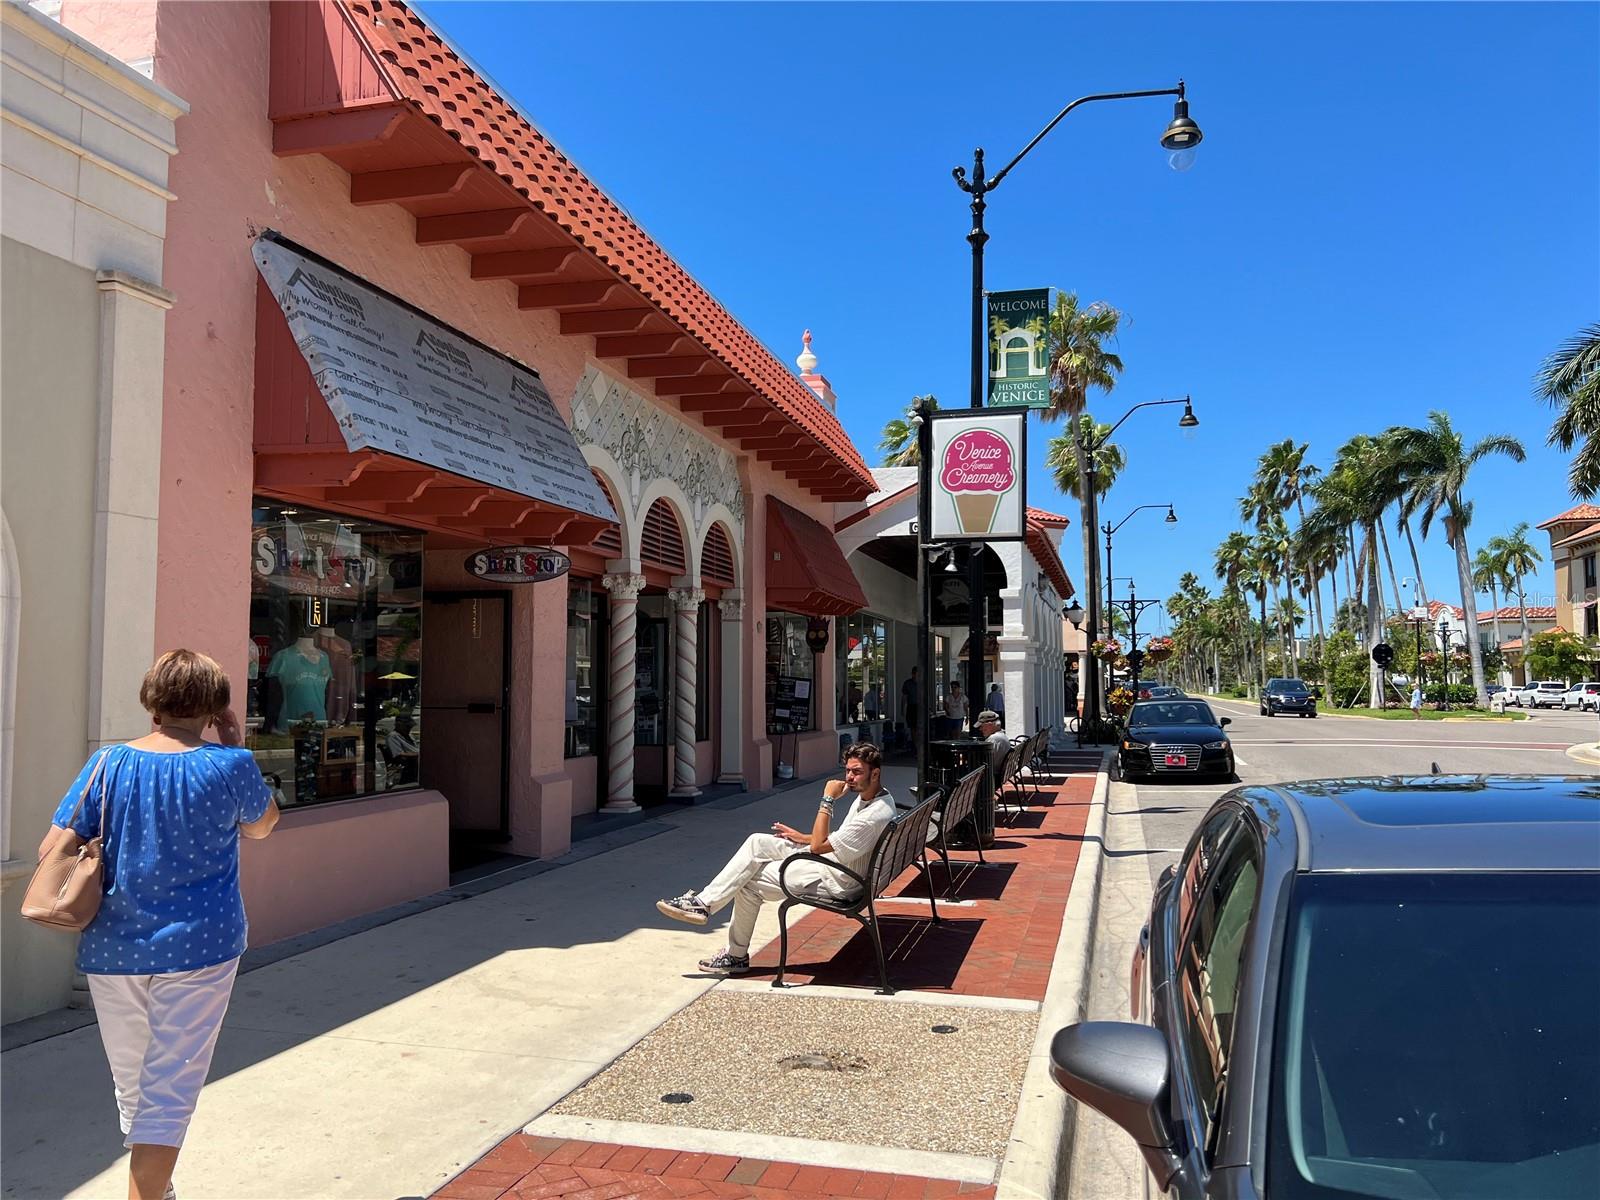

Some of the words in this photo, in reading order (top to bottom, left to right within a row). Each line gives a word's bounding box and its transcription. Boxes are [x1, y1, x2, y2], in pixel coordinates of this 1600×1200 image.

[301, 295, 333, 320] Worry
[339, 312, 358, 328] Call
[989, 299, 1047, 312] WELCOME
[998, 381, 1040, 391] HISTORIC
[991, 389, 1046, 403] VENICE
[954, 440, 1002, 461] Venice
[961, 459, 994, 472] Avenue
[946, 468, 1008, 489] Creamery
